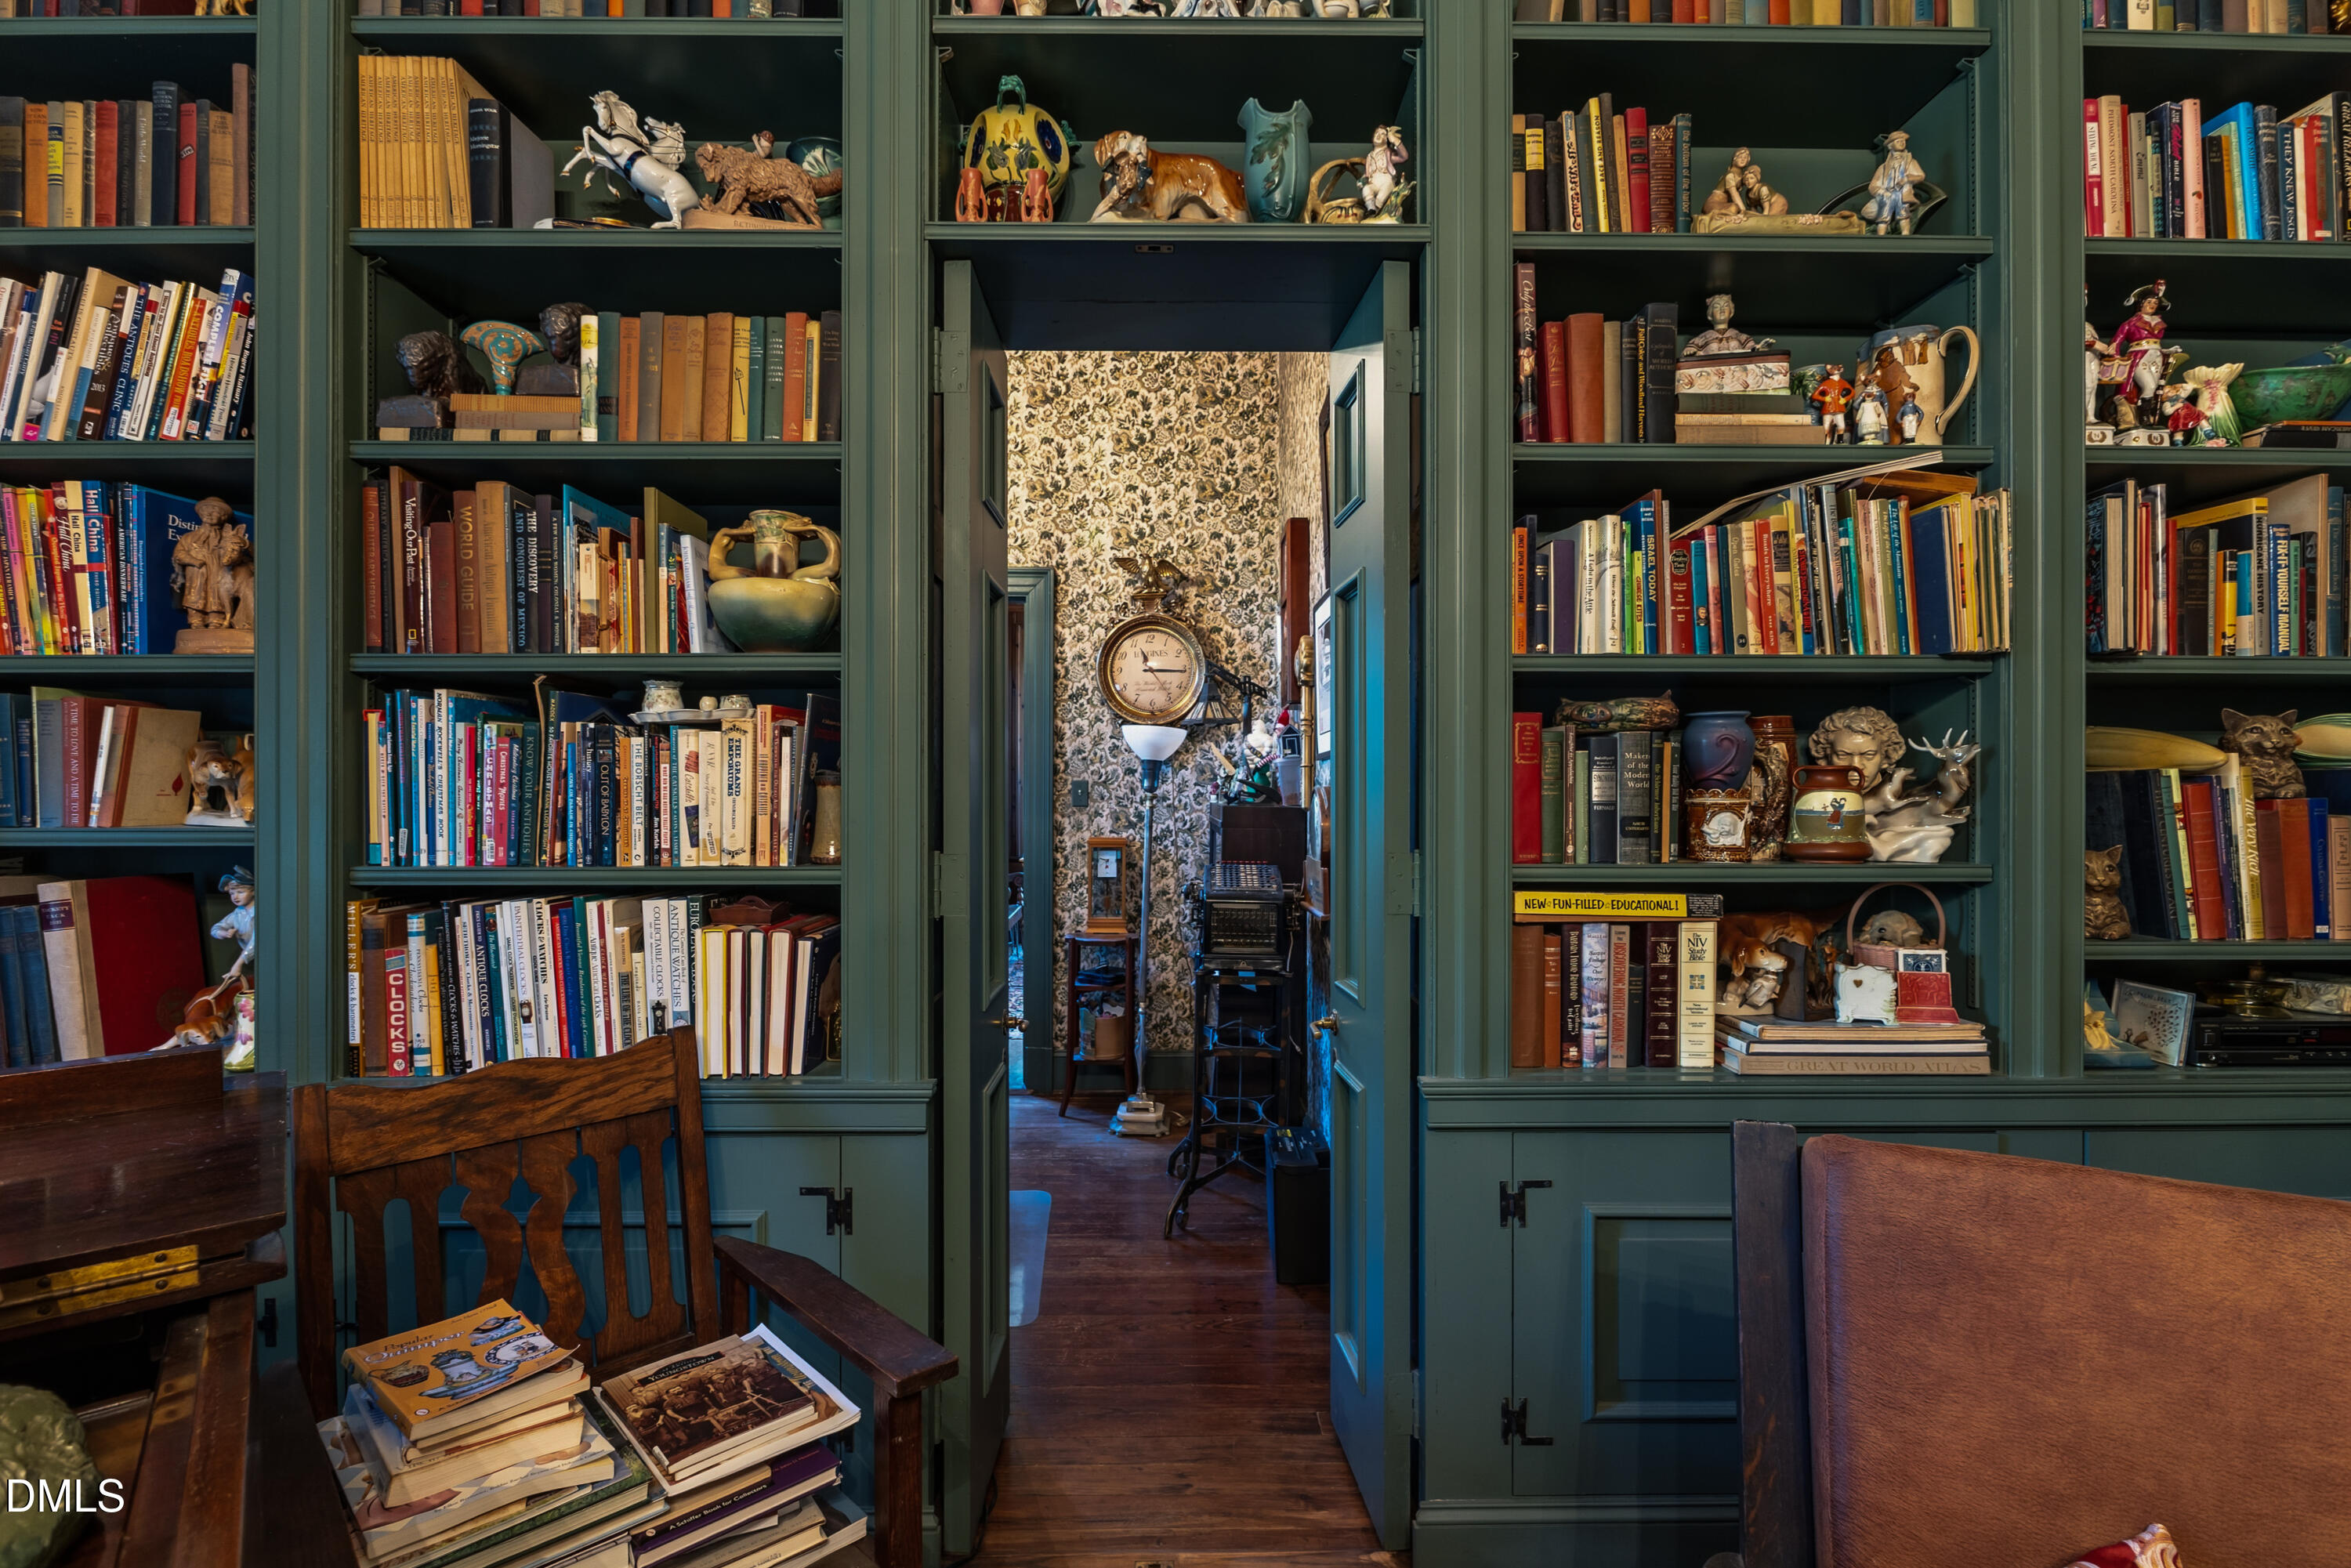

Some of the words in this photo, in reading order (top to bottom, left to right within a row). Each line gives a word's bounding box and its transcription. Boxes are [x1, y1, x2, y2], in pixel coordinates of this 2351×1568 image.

[2135, 152, 2146, 179] Emma
[1521, 281, 1534, 302] Only
[132, 299, 143, 320] THE
[183, 312, 201, 350] ANTIQUES
[203, 305, 223, 365] COMPLETE
[1524, 317, 1533, 341] Best
[1637, 328, 1646, 341] Fall
[121, 324, 141, 374] ANTIQUES
[238, 350, 251, 374] Rogers
[175, 352, 191, 393] ROADSHOW
[195, 366, 209, 401] FIX-IT
[90, 382, 106, 393] 2013
[112, 378, 128, 411] CLINIC
[234, 374, 247, 404] Statuary
[1637, 375, 1646, 408] Woodland
[1636, 409, 1646, 438] Harvests
[85, 490, 100, 512] Hall
[404, 498, 416, 529] Visiting
[56, 516, 71, 540] Hall
[71, 516, 80, 528] Hall
[88, 519, 102, 552] China
[459, 506, 473, 559] WORLD
[515, 512, 523, 532] AND
[527, 512, 537, 532] THE
[73, 533, 82, 552] China
[406, 530, 417, 548] Our
[60, 542, 73, 571] China
[407, 548, 418, 564] Past
[516, 537, 525, 588] CONQUEST
[527, 538, 538, 593] DISCOVERY
[461, 567, 474, 610] GUIDE
[1647, 570, 1656, 602] TODAY
[2277, 540, 2288, 612] FIX-IT-YOURSELF
[517, 592, 525, 603] OF
[2278, 614, 2289, 653] MANUAL
[1118, 651, 1127, 661] 10
[1176, 649, 1183, 657] 2
[1134, 694, 1139, 704] 7
[1166, 693, 1172, 701] 5
[1176, 681, 1183, 690] 4
[71, 726, 78, 737] TO
[526, 736, 534, 768] KNOW
[524, 771, 534, 801] YOUR
[600, 765, 609, 782] OUT
[71, 782, 79, 800] TIME
[498, 787, 507, 810] MOVIES
[600, 784, 609, 796] OF
[71, 802, 79, 812] TO
[71, 813, 80, 824] DIE
[601, 798, 610, 835] BABYLON
[522, 804, 533, 853] ANTIQUES
[534, 901, 545, 934] CLOCKS
[1524, 899, 1546, 909] NEW
[1552, 898, 1604, 910] FUN-FILLED
[1611, 900, 1679, 911] EDUCATIONAL!
[348, 905, 358, 969] MILLER'S
[670, 904, 680, 954] ANTIQUE
[1687, 938, 1707, 947] NIV
[476, 944, 487, 982] ANTIQUE
[538, 944, 548, 984] WATCHES
[1614, 943, 1627, 986] DISCOVERING
[671, 958, 681, 1007] WATCHES
[389, 973, 405, 1052] CLOCKS
[479, 984, 490, 1017] CLOCKS
[1613, 987, 1626, 1010] NORTH
[1612, 1012, 1625, 1043] CAROLINA
[1788, 1061, 1849, 1071] GREAT
[1854, 1061, 1915, 1072] WORLD
[1924, 1062, 1981, 1073] ATLAS
